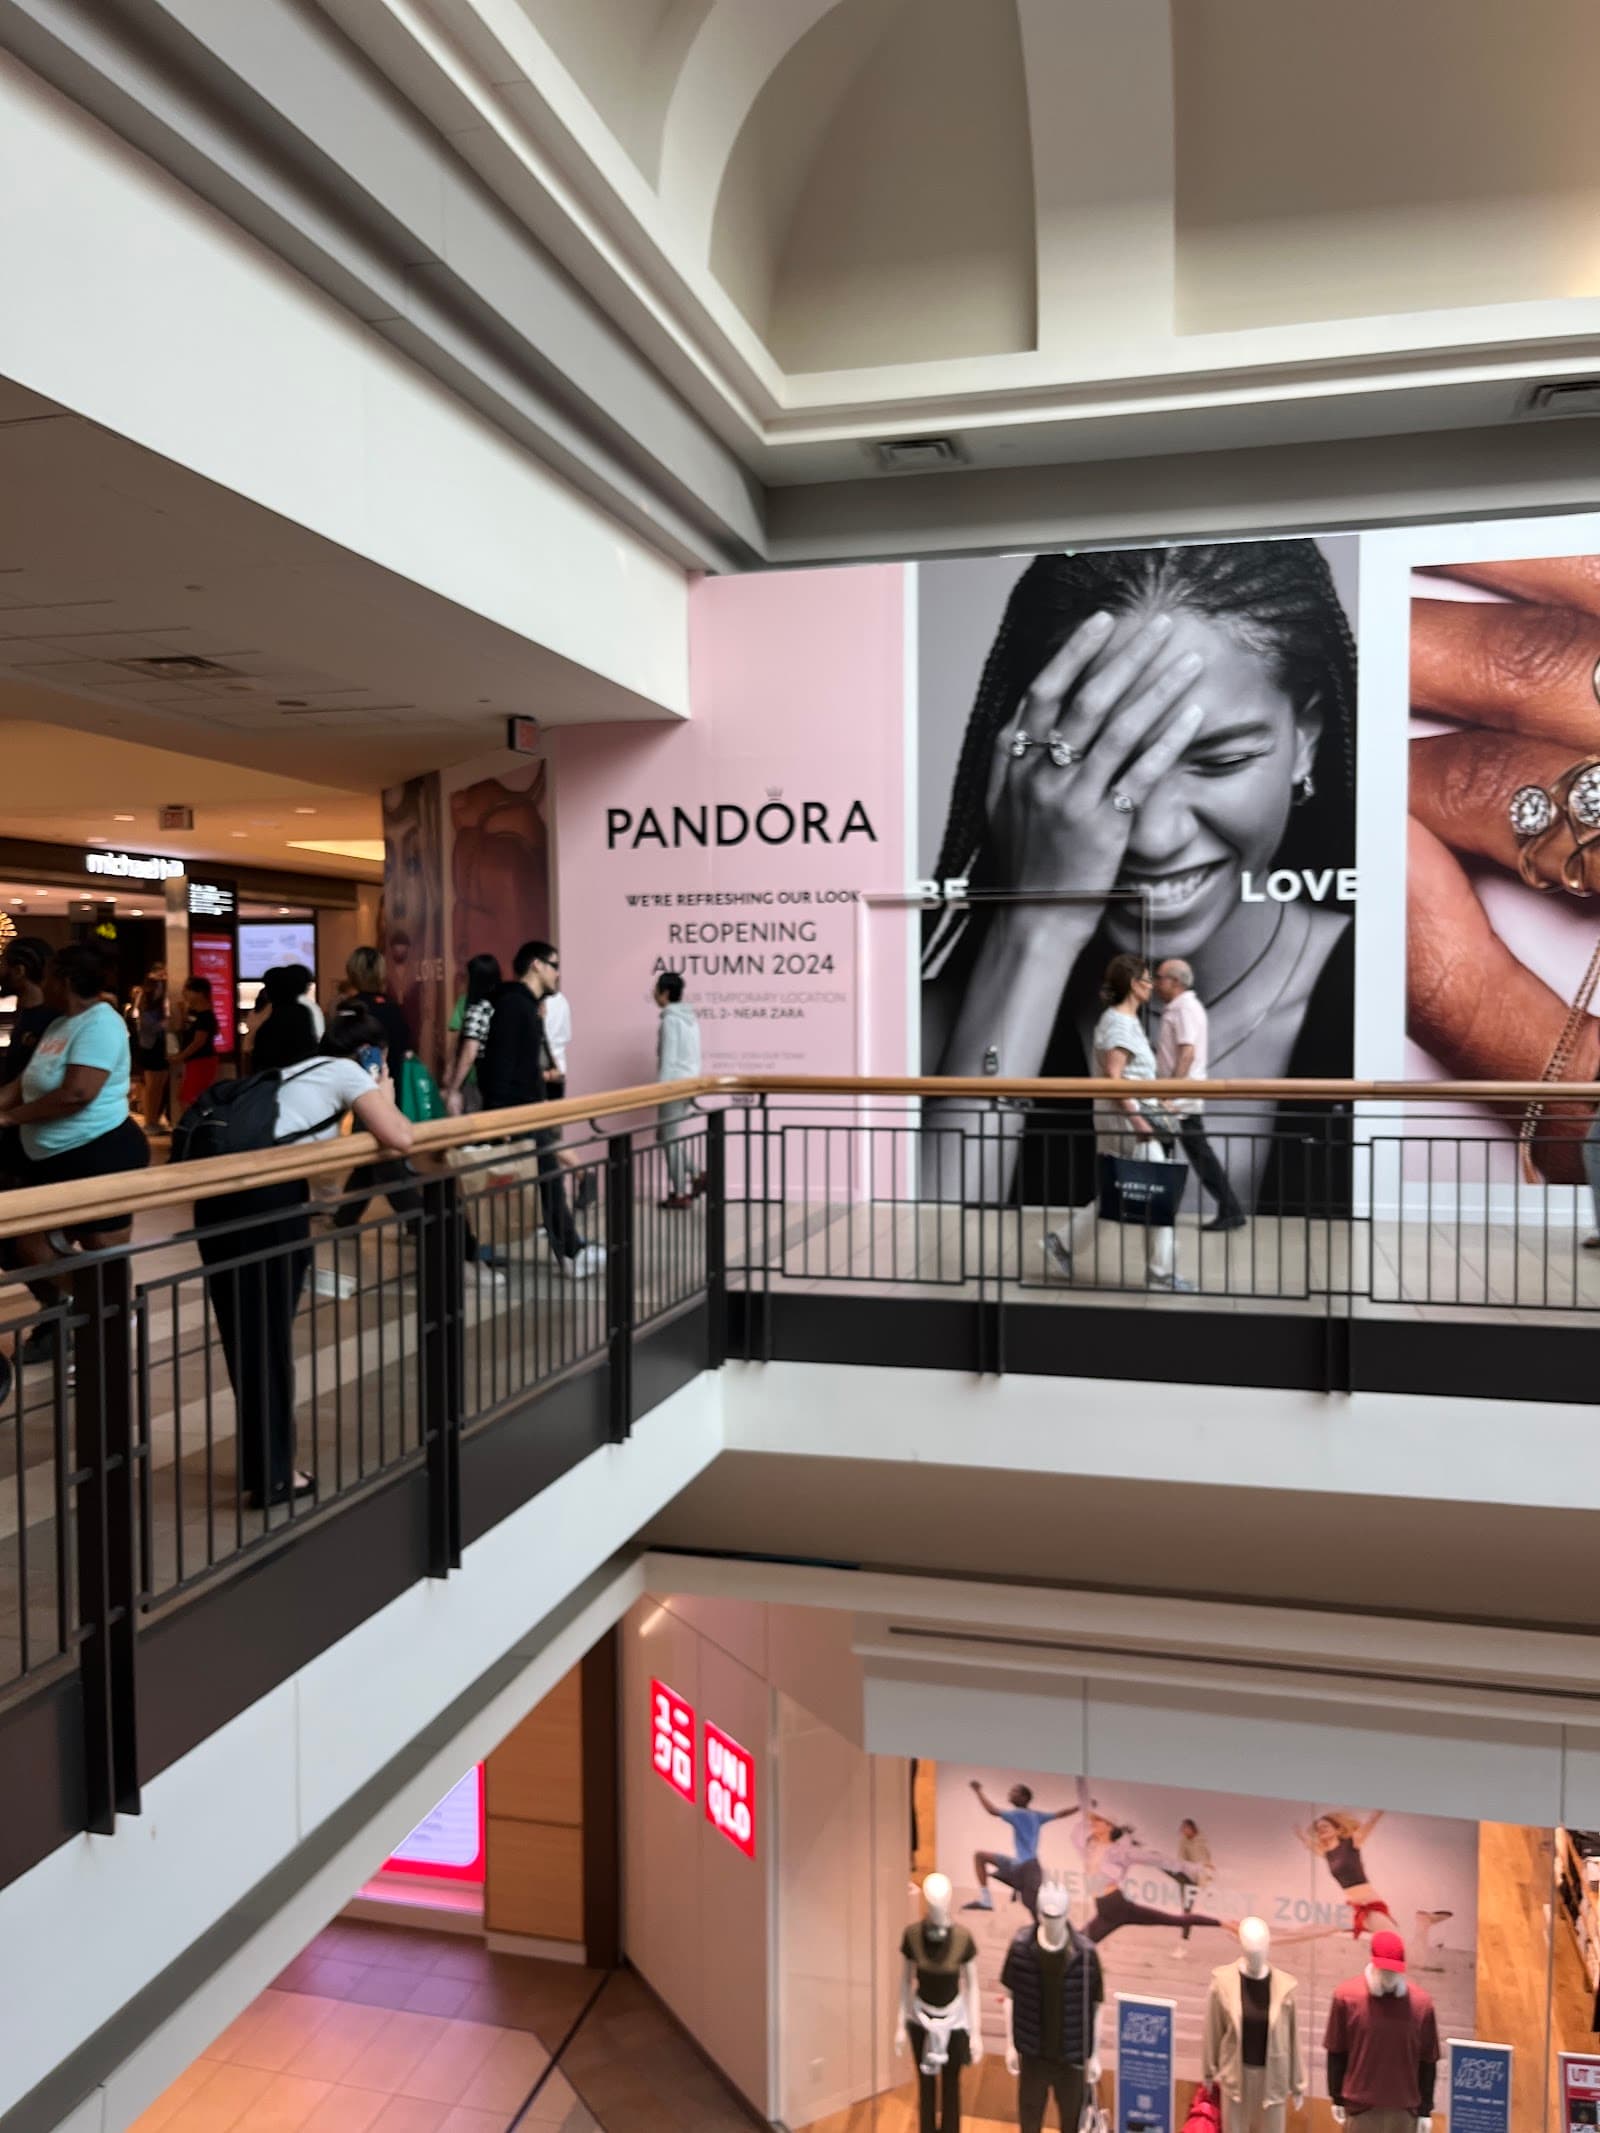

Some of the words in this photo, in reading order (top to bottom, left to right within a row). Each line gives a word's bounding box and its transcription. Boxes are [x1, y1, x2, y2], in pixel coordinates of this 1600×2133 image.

[606, 800, 878, 849] PANDORA
[625, 894, 673, 907] WE'RE
[677, 892, 774, 906] REFRESHING
[777, 891, 812, 905] OUR
[816, 890, 860, 904] LOOK
[916, 877, 970, 910] BE
[1241, 868, 1359, 902] LOVE
[669, 921, 817, 943] REOPENING
[652, 954, 764, 976] AUTUMN
[773, 954, 835, 975] 2024
[695, 1008, 717, 1019] VEL
[734, 1008, 768, 1019] NEAR
[770, 1008, 805, 1019] ZARA
[1275, 1896, 1353, 1928] ZONE
